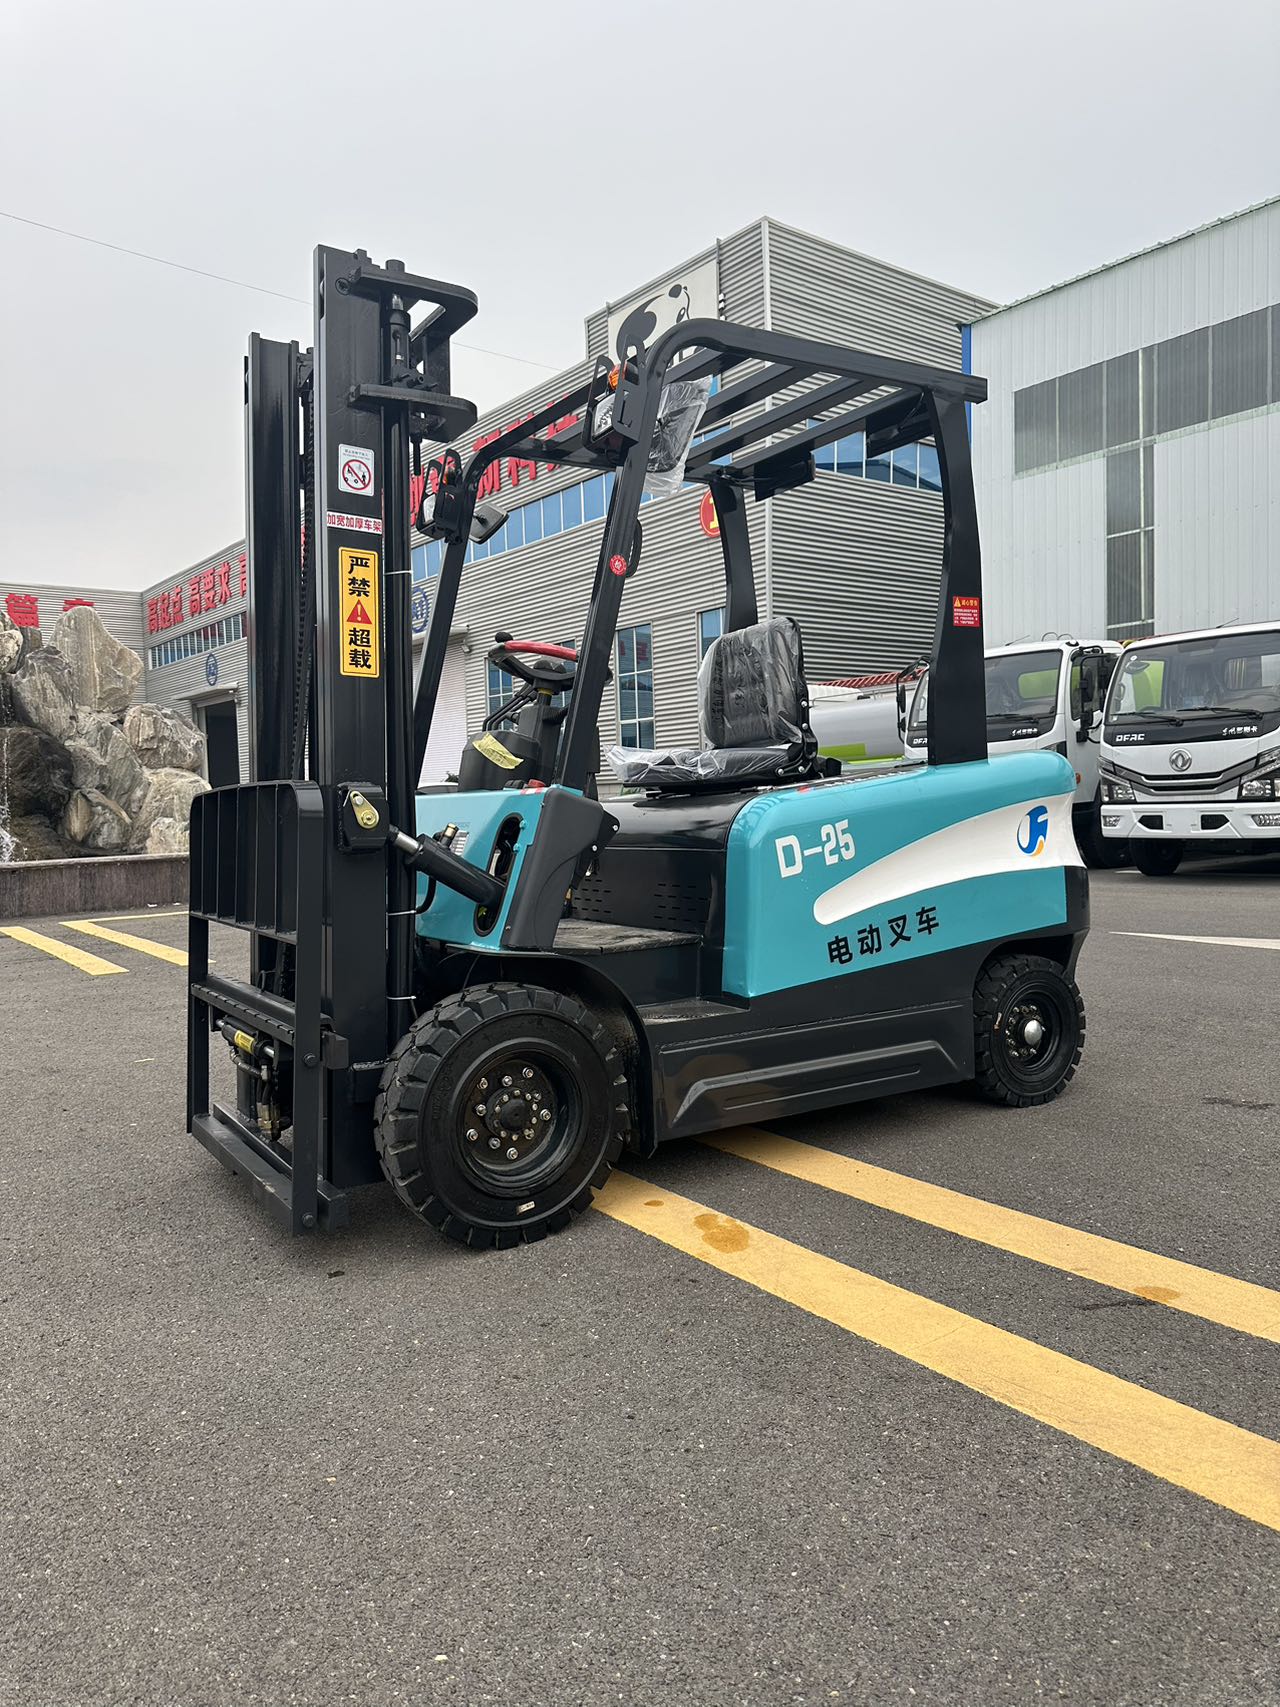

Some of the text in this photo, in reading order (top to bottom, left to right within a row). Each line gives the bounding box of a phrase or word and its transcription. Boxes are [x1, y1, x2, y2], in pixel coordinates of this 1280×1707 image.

[327, 513, 382, 532] 加宽加厚车架
[147, 586, 184, 634] 高起点
[188, 562, 232, 617] 高要求
[912, 737, 929, 745] DFA
[1115, 733, 1145, 742] DFAC
[775, 819, 855, 878] D-25
[827, 906, 940, 964] 电动叉车
